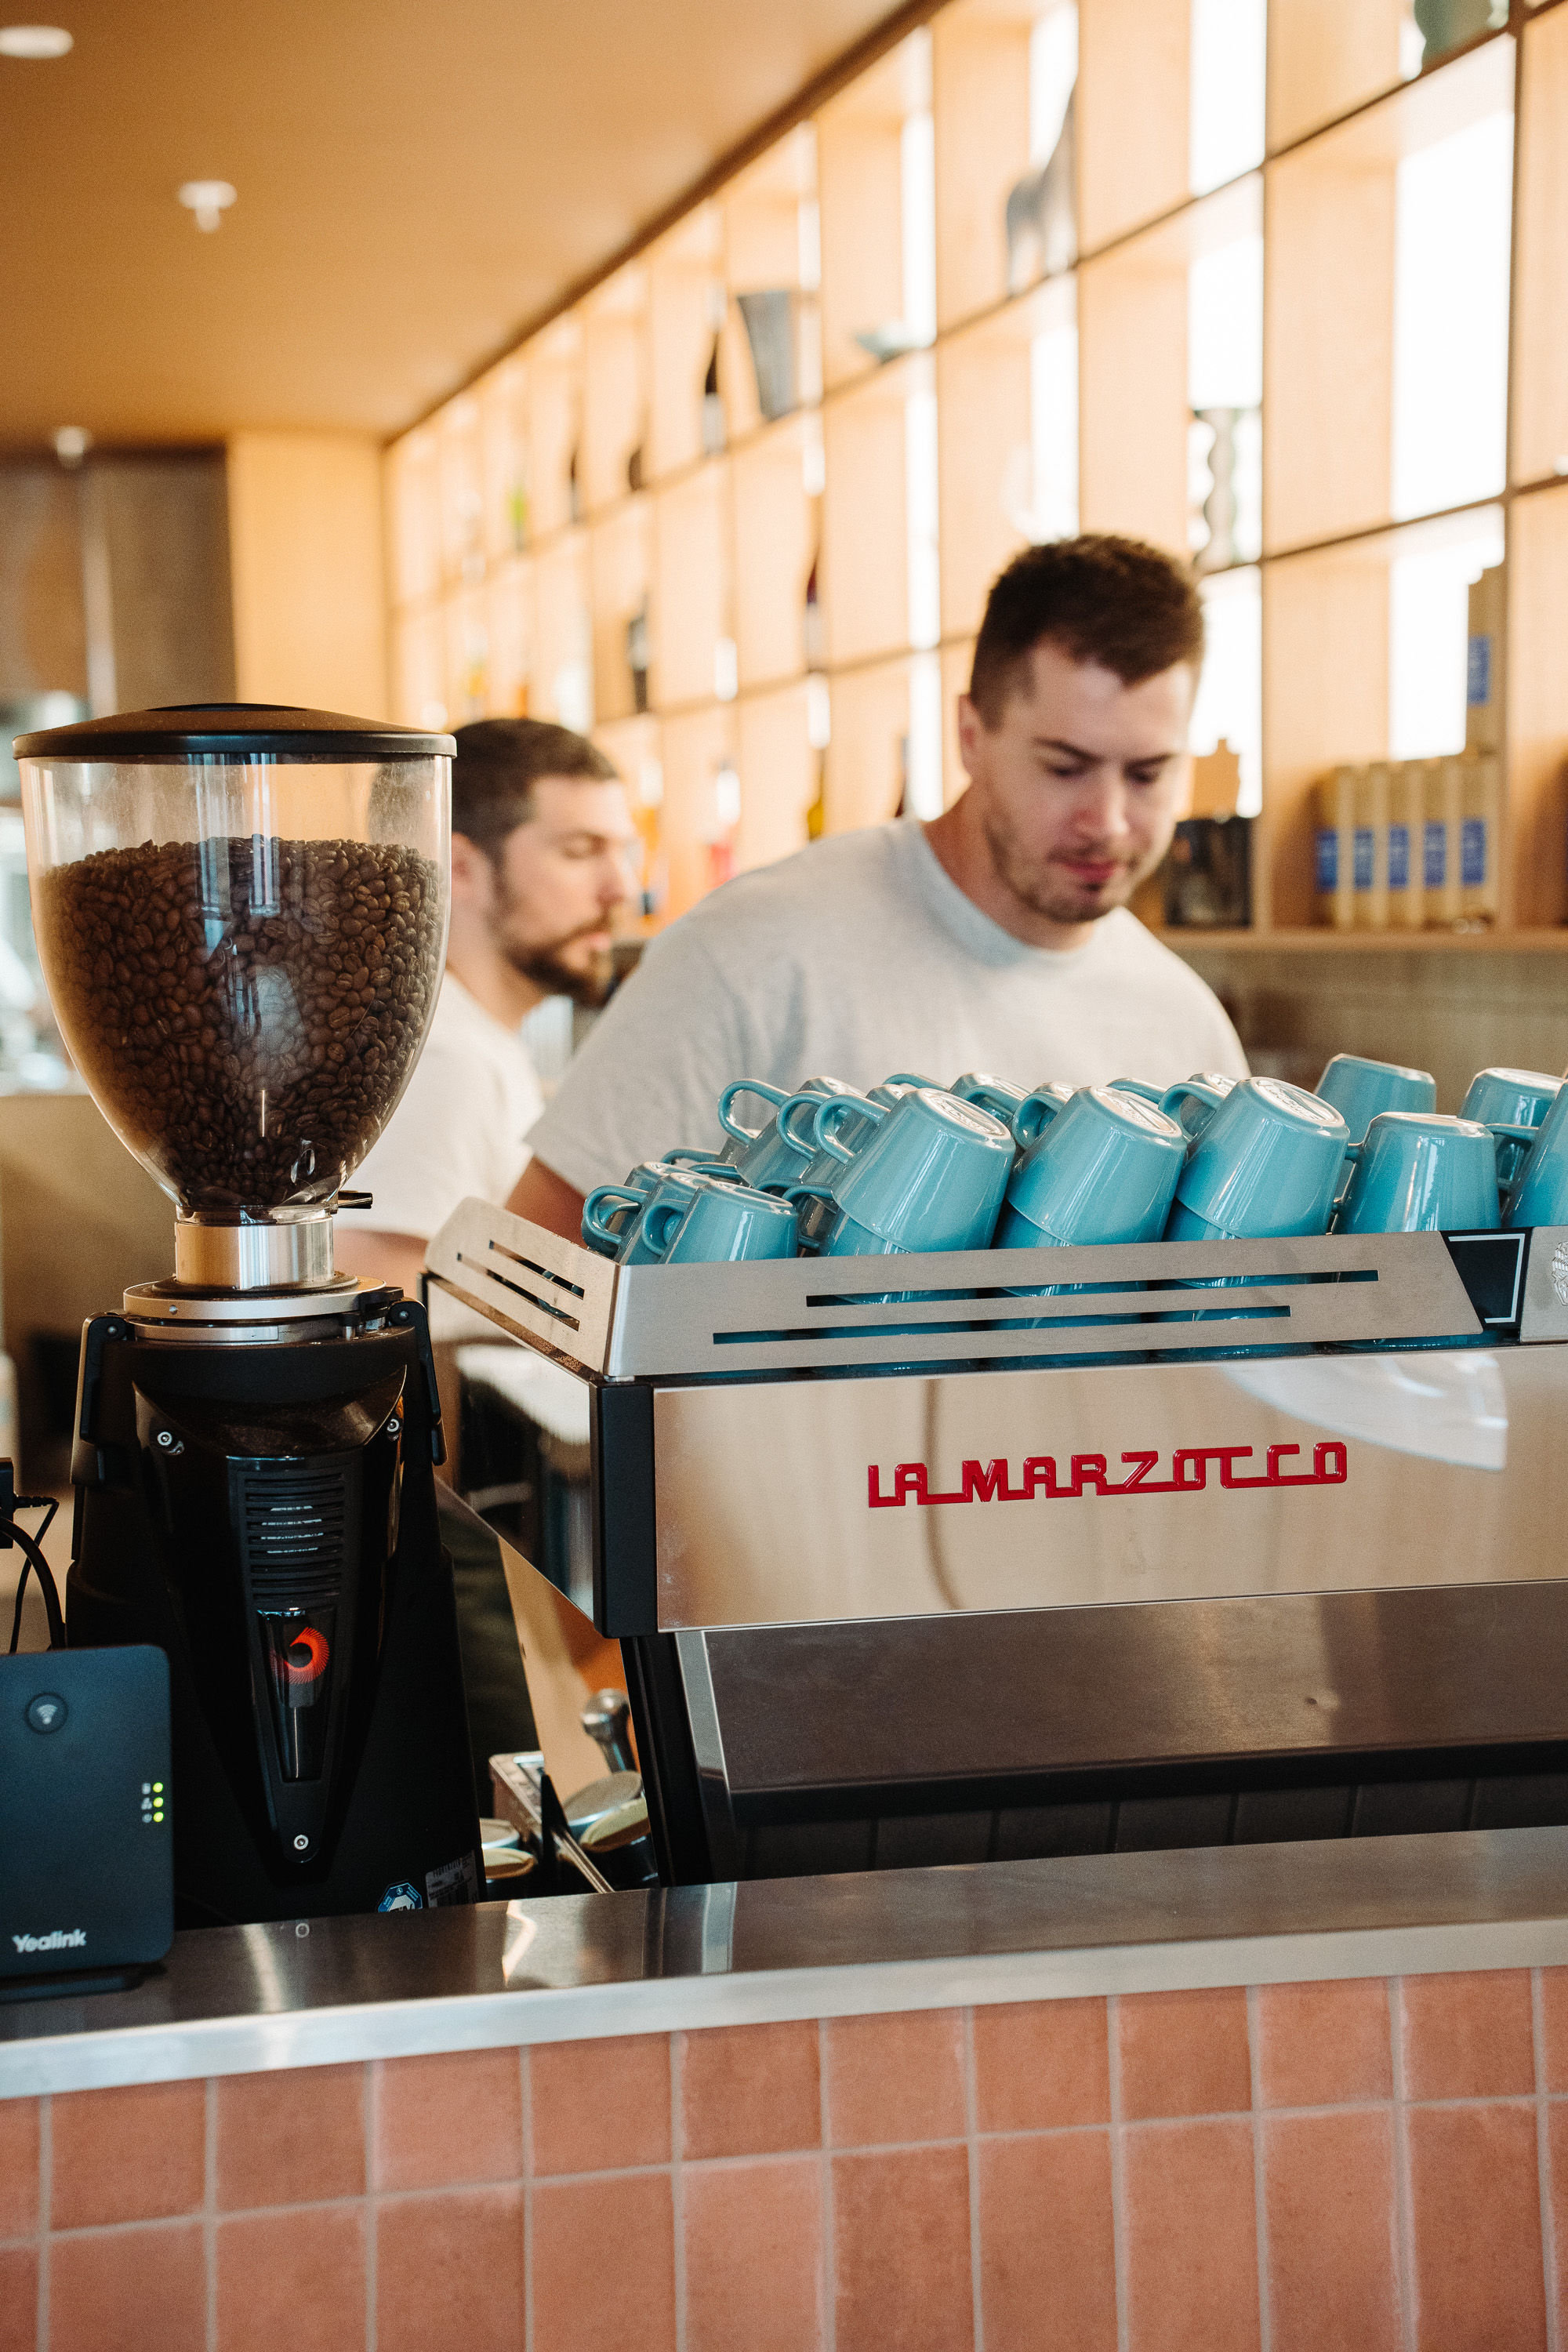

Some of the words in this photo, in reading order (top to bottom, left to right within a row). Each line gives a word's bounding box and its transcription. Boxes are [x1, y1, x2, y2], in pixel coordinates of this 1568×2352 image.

[868, 1463, 928, 1508] LA
[962, 1442, 1347, 1503] MARZOCCO
[12, 1929, 87, 1953] Yealink
